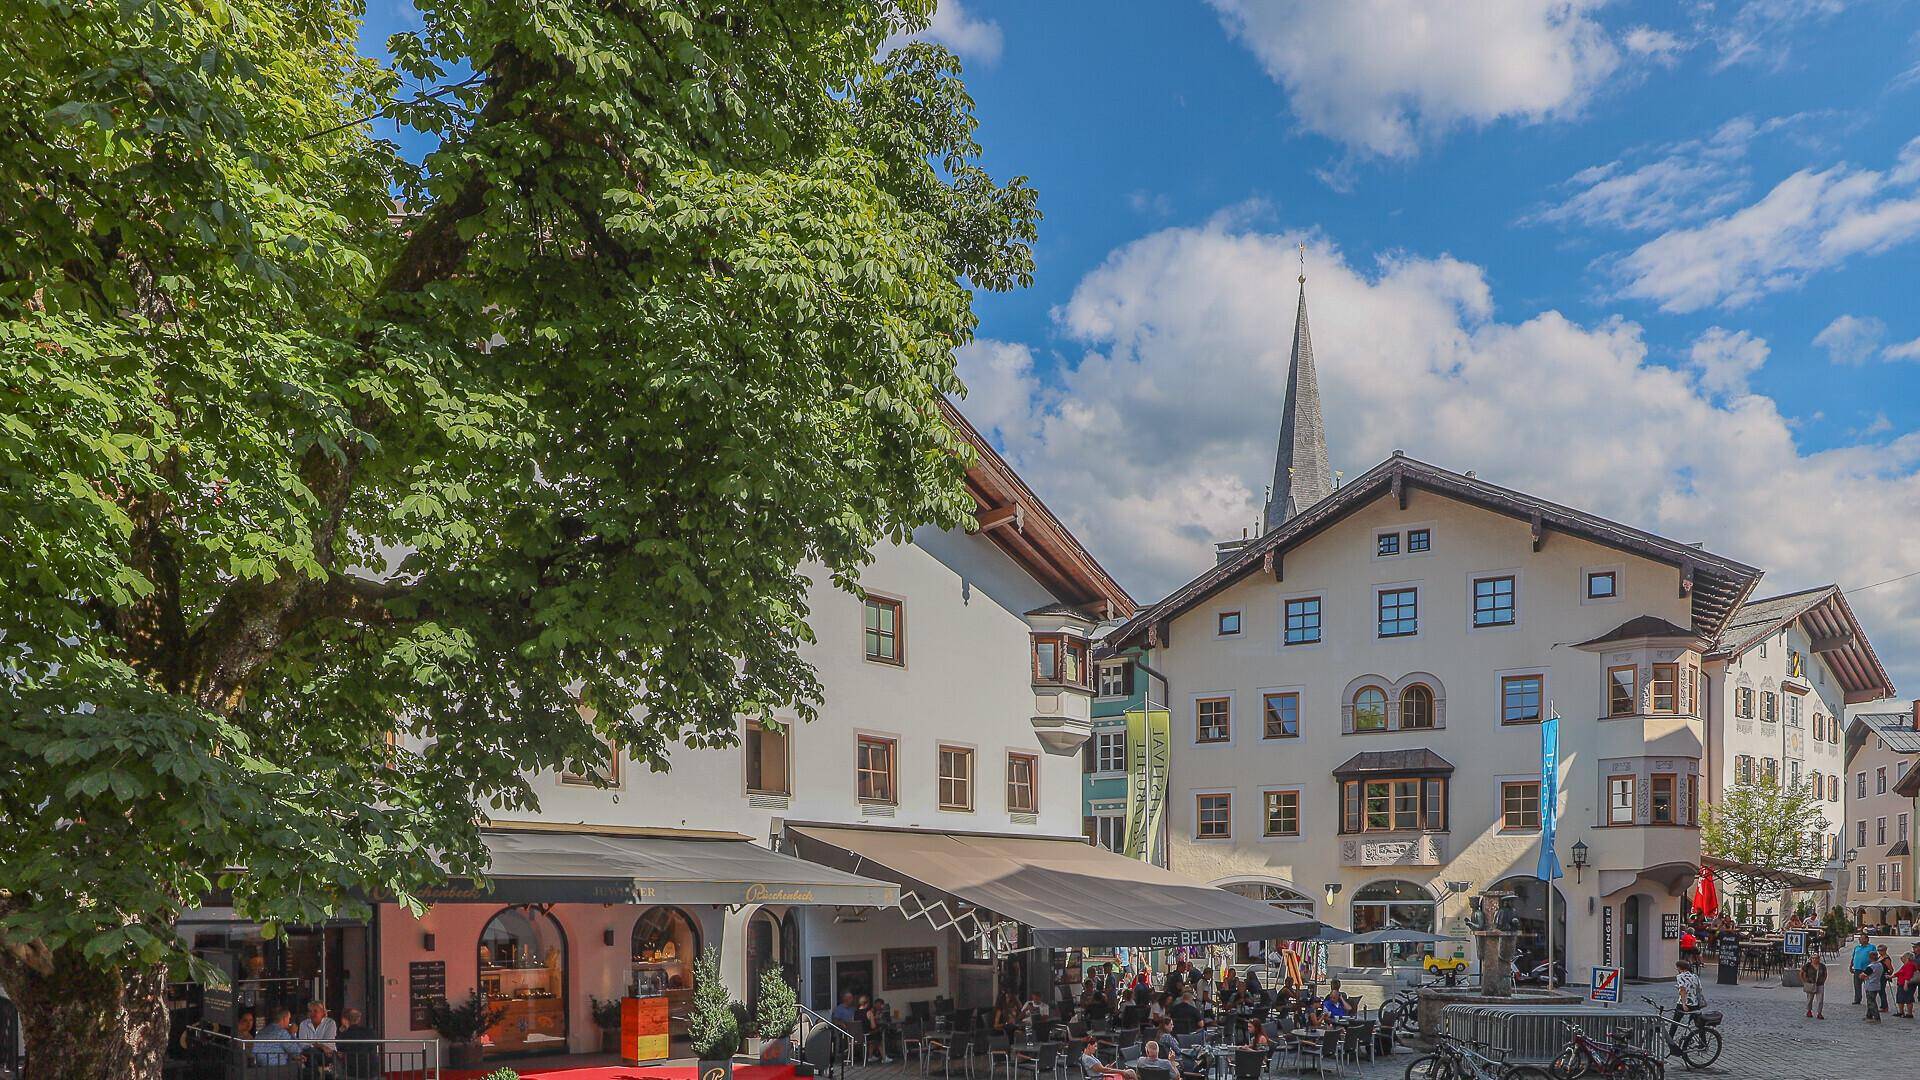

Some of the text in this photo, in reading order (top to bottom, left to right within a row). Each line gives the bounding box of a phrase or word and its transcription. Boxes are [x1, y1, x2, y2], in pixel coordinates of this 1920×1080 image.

[592, 887, 656, 897] JUWEER
[1150, 929, 1237, 946] CAFFÈ BELUNA
